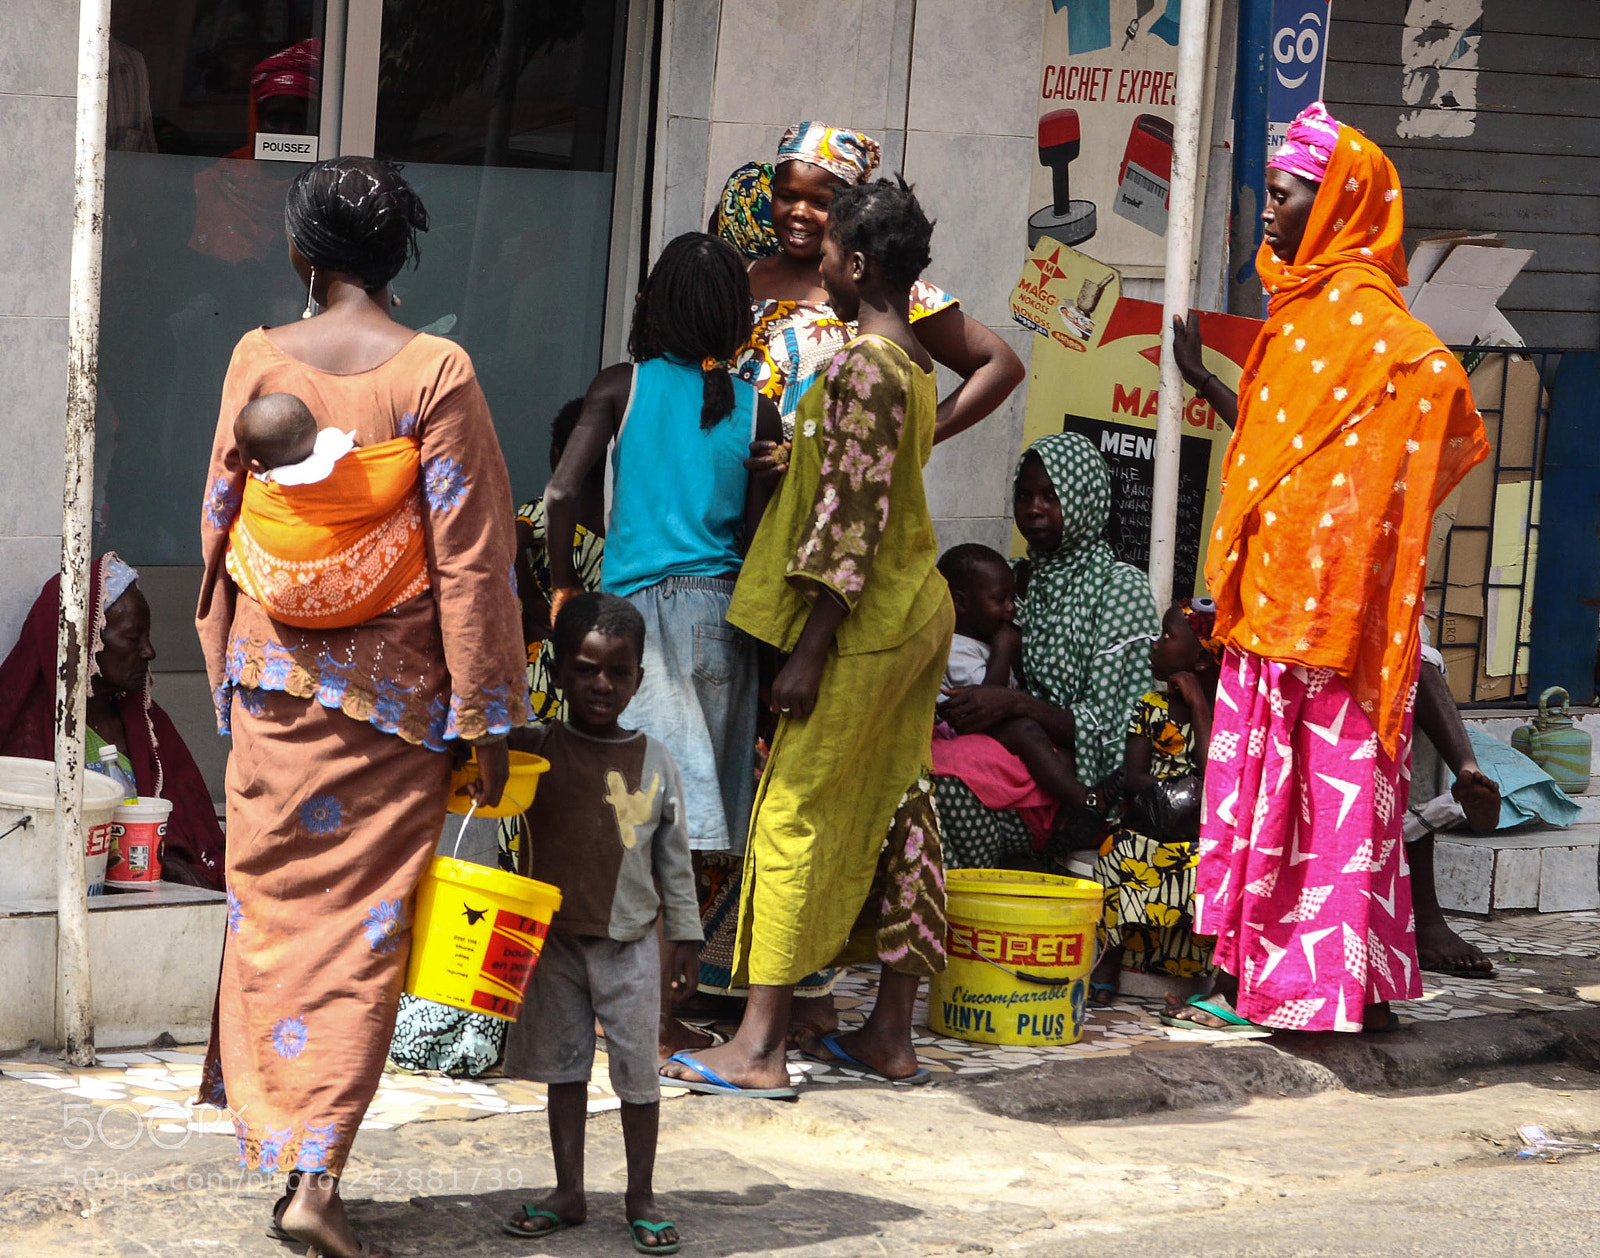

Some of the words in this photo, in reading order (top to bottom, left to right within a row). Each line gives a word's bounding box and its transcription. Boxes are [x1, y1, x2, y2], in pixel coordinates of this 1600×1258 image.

[1273, 27, 1319, 64] GO
[1042, 65, 1113, 102] CACHET
[262, 141, 311, 154] POUSSEZ
[1018, 293, 1050, 315] NOKOSS
[1112, 383, 1216, 430] MAGI
[1100, 430, 1157, 460] MEN
[952, 985, 1069, 1008] l'incomparable
[943, 1001, 996, 1034] VINYL
[1016, 1013, 1065, 1036] PLUS
